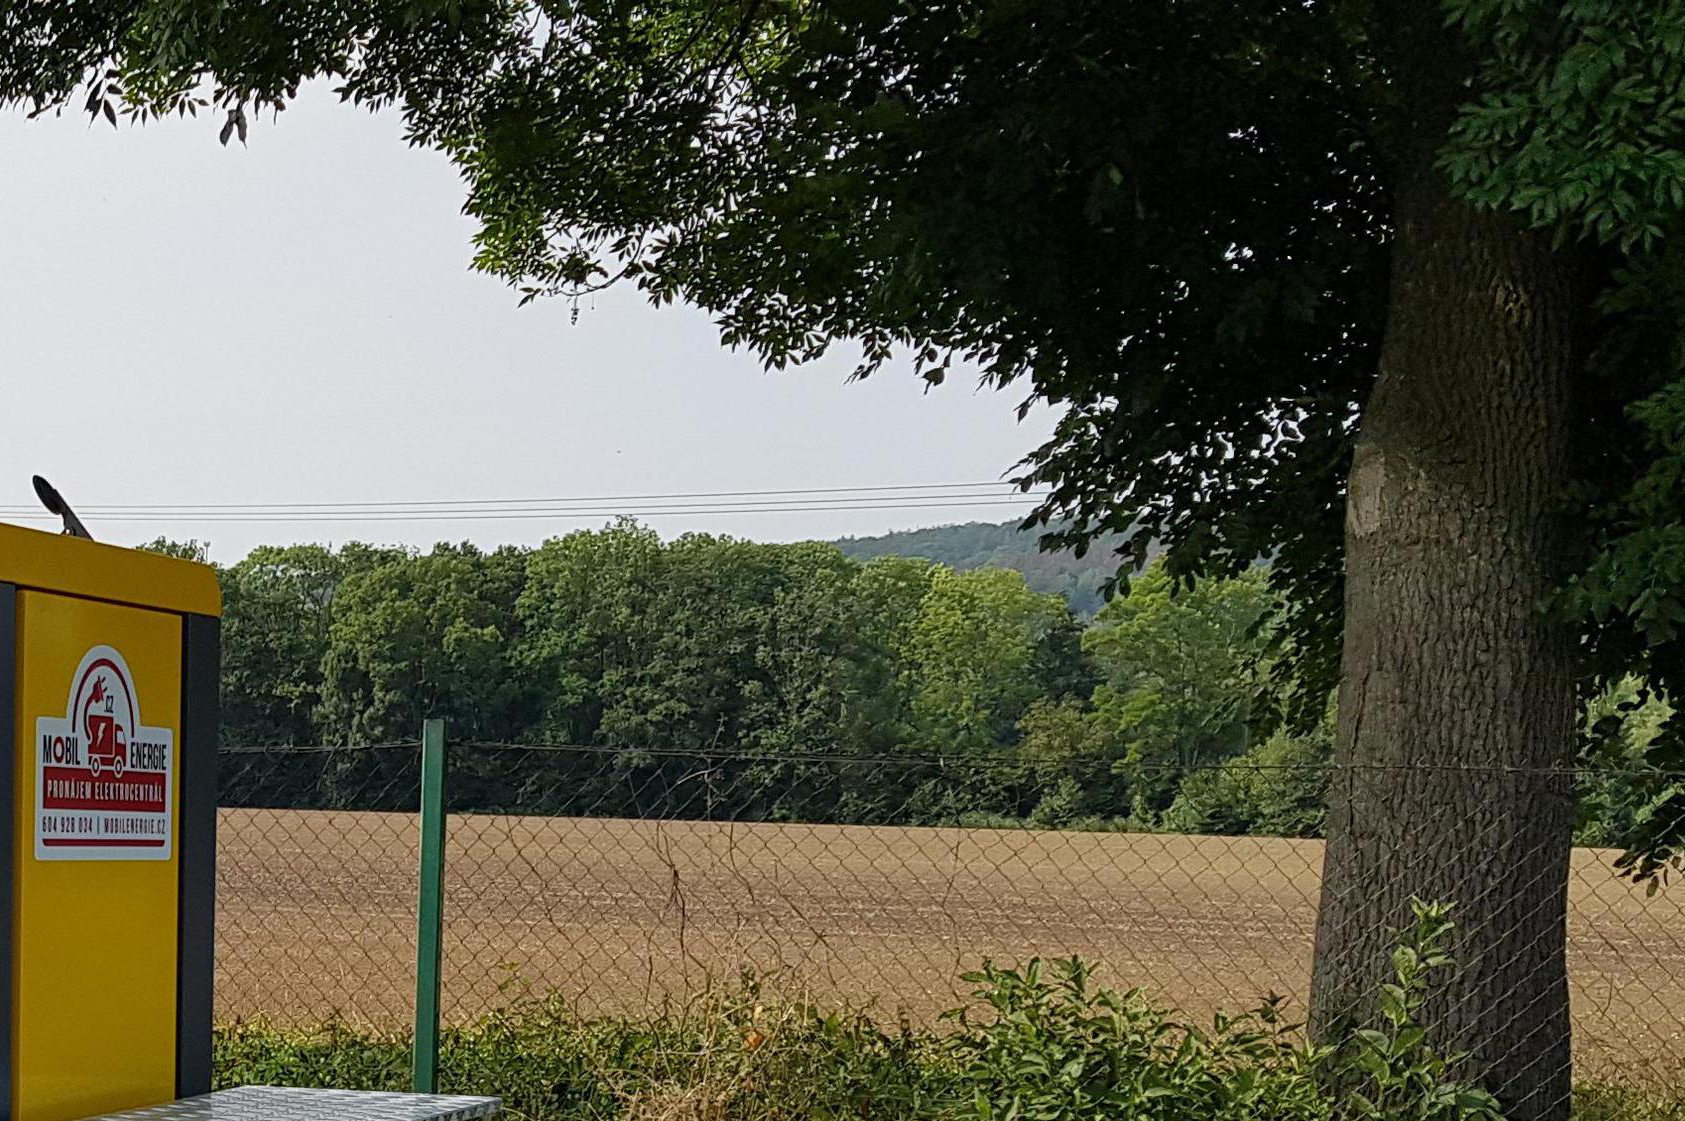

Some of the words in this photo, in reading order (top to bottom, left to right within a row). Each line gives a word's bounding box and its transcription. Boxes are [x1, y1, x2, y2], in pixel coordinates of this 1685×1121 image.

[43, 735, 80, 765] MOBIL
[130, 741, 167, 771] ENERGIE
[47, 778, 91, 799] PRONÁJEM
[95, 781, 163, 802] ELEKTROCENTRÁL
[42, 816, 58, 833] 604
[60, 816, 76, 833] 928
[77, 817, 93, 833] 034
[103, 817, 166, 835] MOBILENERGIE.CZ
